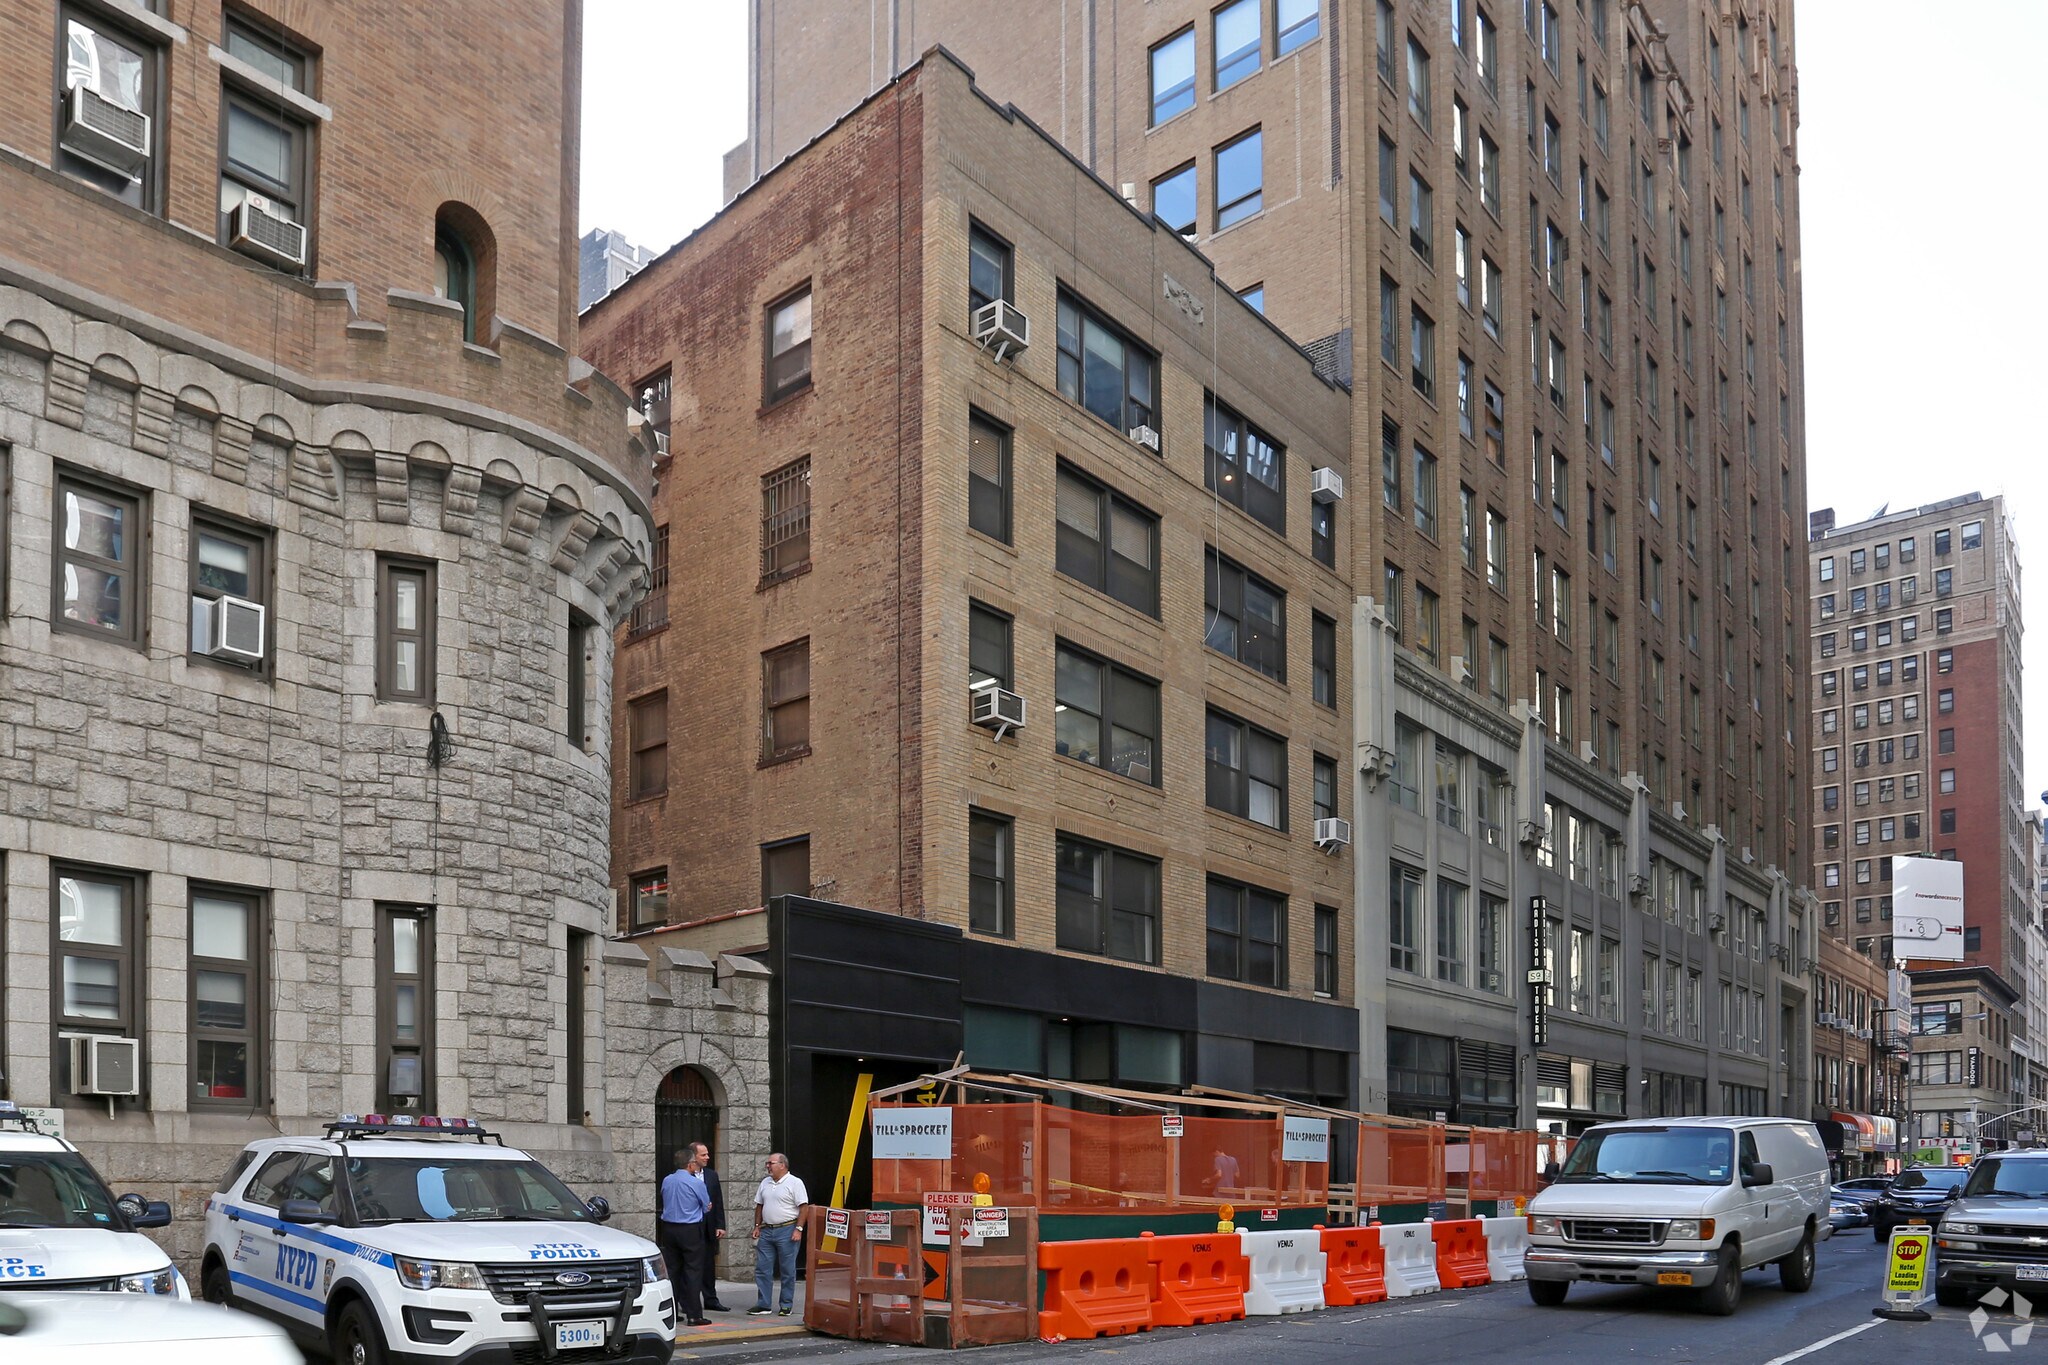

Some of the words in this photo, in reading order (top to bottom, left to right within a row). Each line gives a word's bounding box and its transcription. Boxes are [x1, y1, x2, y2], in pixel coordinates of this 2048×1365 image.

[1920, 1139, 1958, 1148] PIZZA
[927, 1195, 959, 1204] PLEASE
[829, 1213, 845, 1221] DANGER
[1192, 1243, 1212, 1252] VENUS
[1277, 1240, 1294, 1248] VENUS
[354, 1245, 380, 1263] POLICE
[528, 1249, 601, 1259] POLICE
[1897, 1245, 1920, 1255] STOP
[275, 1243, 318, 1290] NYPD
[561, 1273, 585, 1283] Ford
[560, 1328, 590, 1343] 5300
